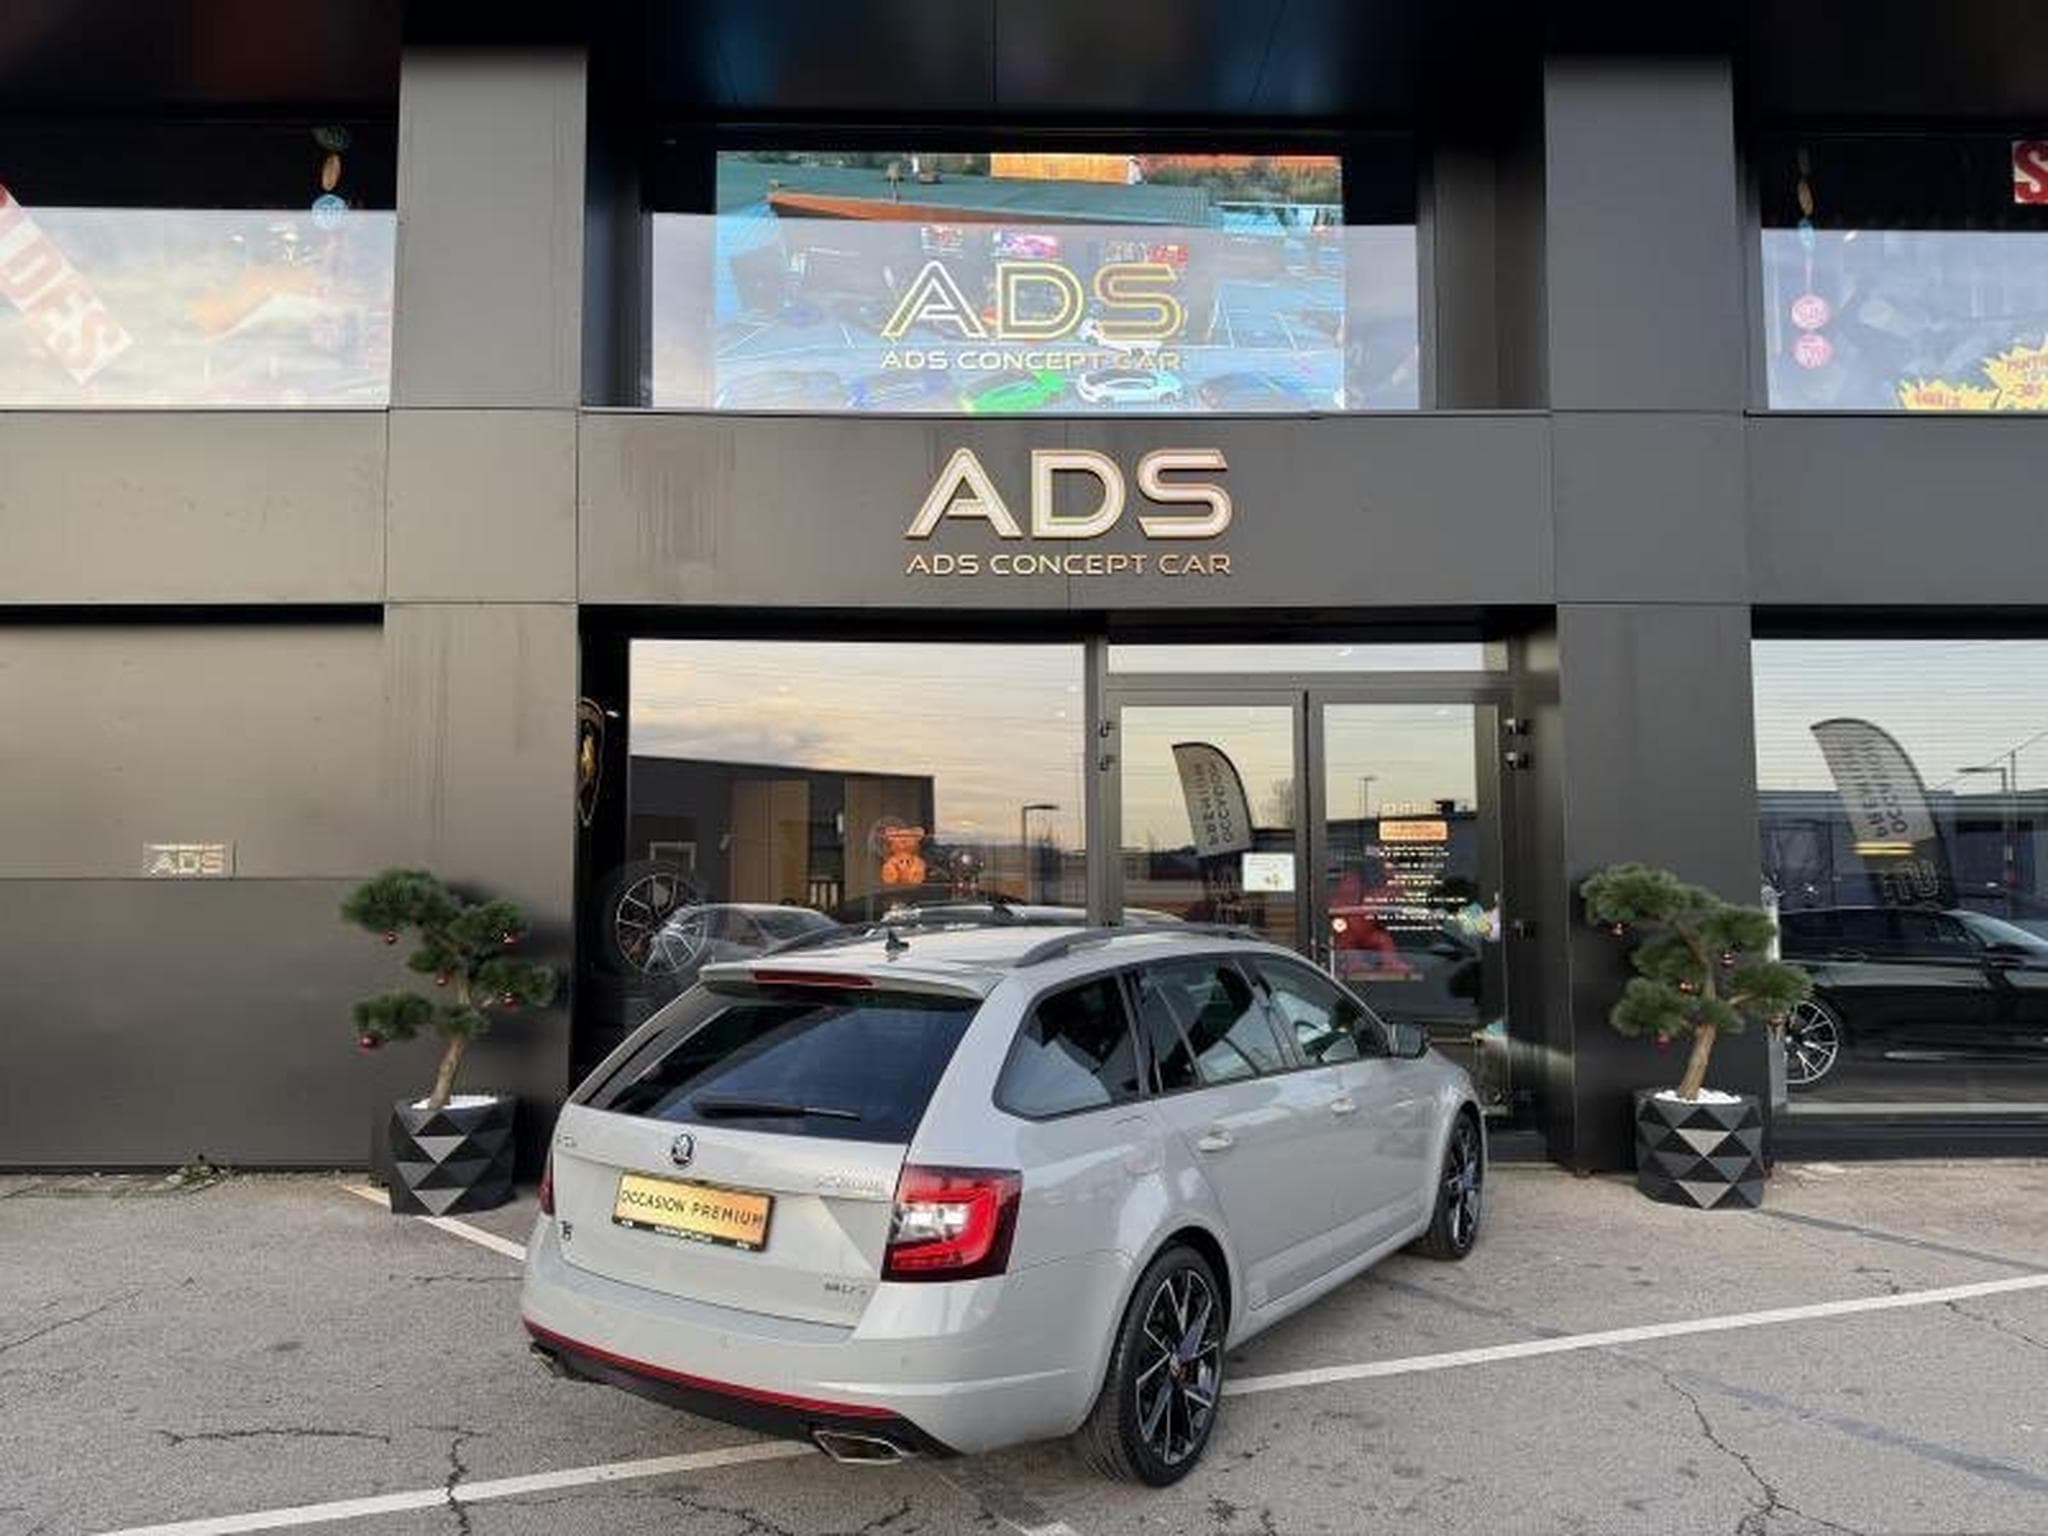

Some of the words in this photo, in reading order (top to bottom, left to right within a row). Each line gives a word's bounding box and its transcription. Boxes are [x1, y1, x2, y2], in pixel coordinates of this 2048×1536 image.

[881, 259, 1185, 341] ADS
[881, 351, 948, 370] ADS
[957, 350, 1106, 370] CONCEPT
[1112, 350, 1181, 370] CAR
[905, 447, 1233, 540] ADS
[906, 555, 979, 576] ADS
[989, 555, 1147, 576] CONCEPT
[1158, 555, 1232, 576] CAR
[621, 1190, 685, 1213] OCCASION
[689, 1201, 763, 1229] PREMIUM
